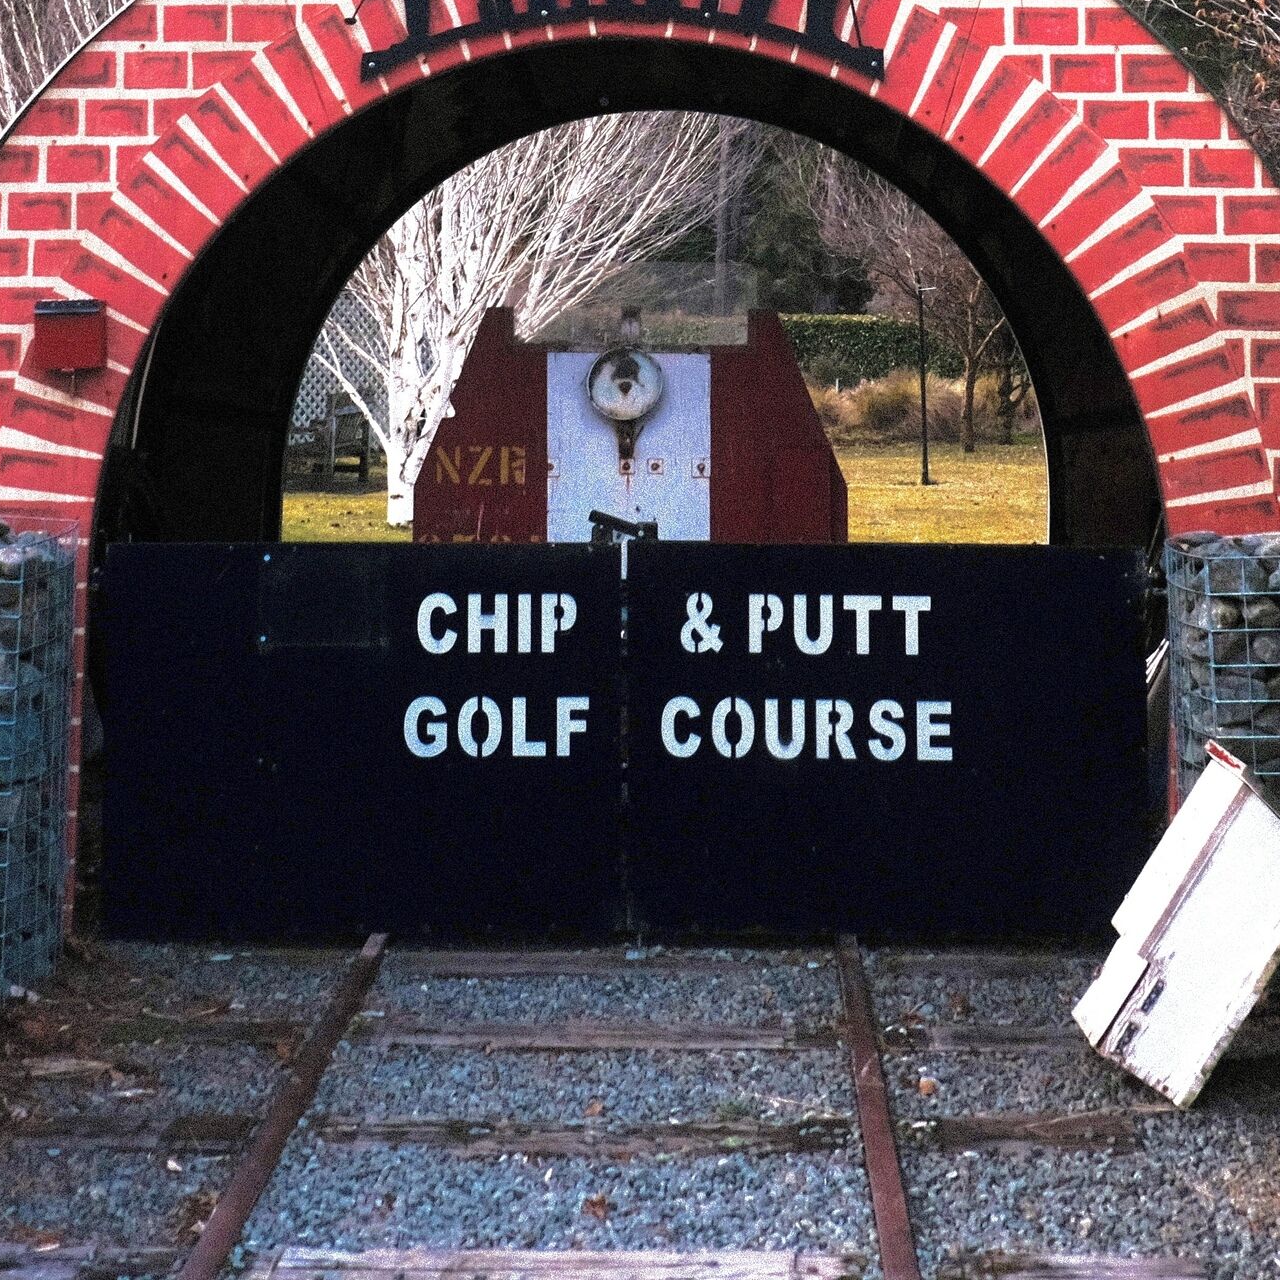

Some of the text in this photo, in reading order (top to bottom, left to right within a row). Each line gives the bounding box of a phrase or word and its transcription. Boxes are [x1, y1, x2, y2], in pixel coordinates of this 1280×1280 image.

[435, 445, 527, 486] NZR
[417, 593, 931, 655] CHIP & PUTT
[404, 697, 953, 761] GOLF COURSE
